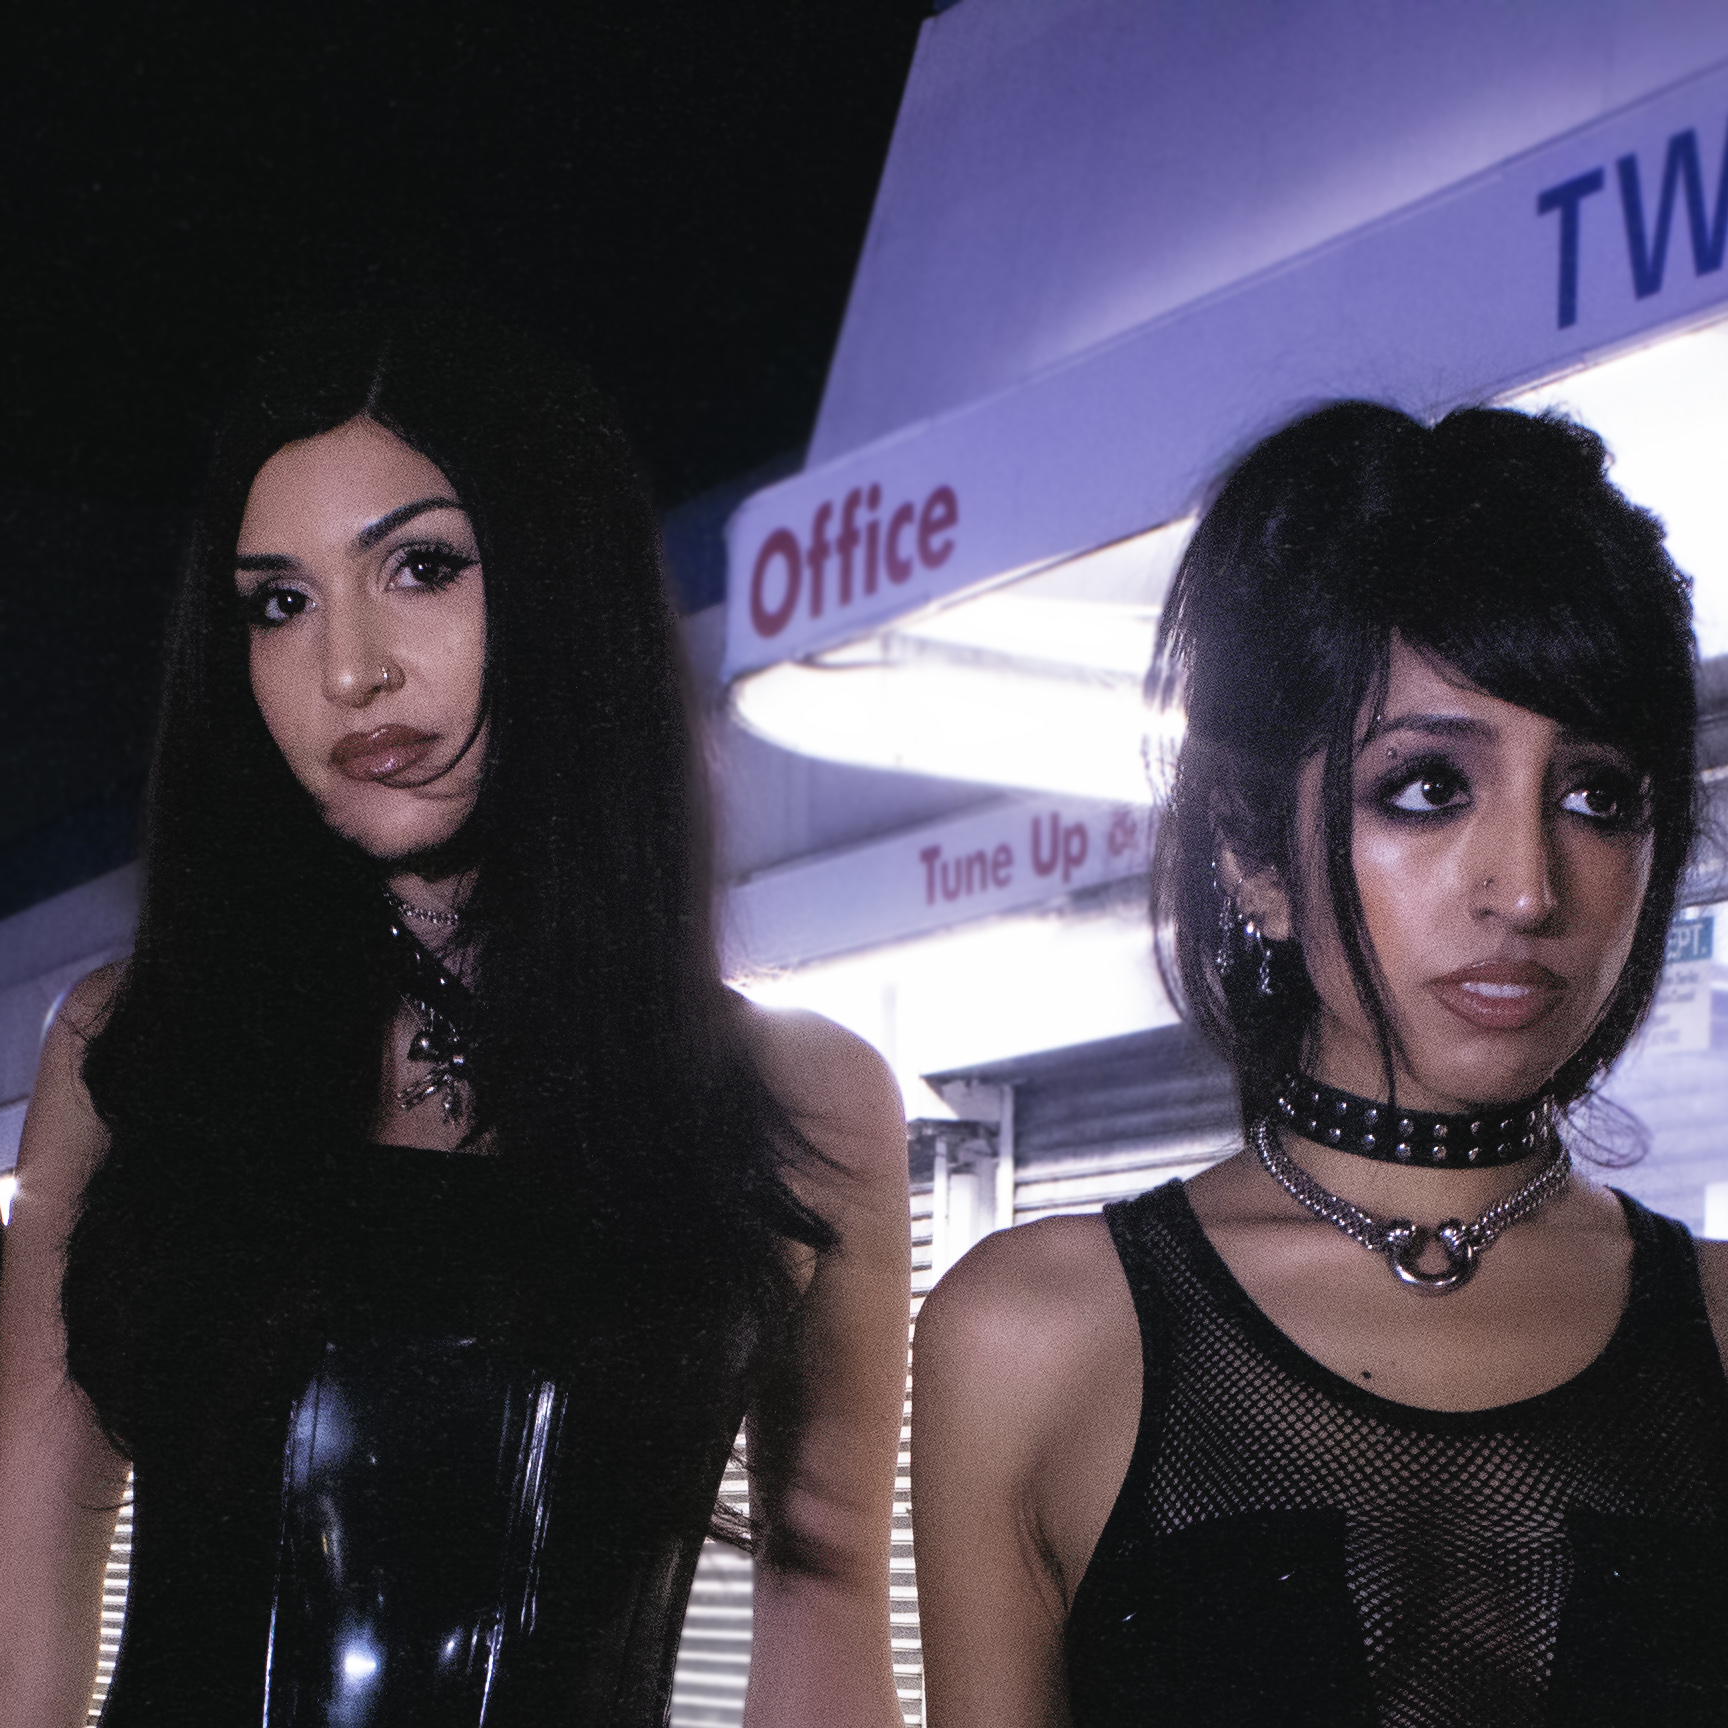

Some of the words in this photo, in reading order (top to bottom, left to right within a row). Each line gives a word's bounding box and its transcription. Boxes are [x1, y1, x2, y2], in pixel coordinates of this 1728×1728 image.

[749, 482, 959, 638] Office
[920, 842, 1013, 906] Tune
[1030, 811, 1088, 883] Up
